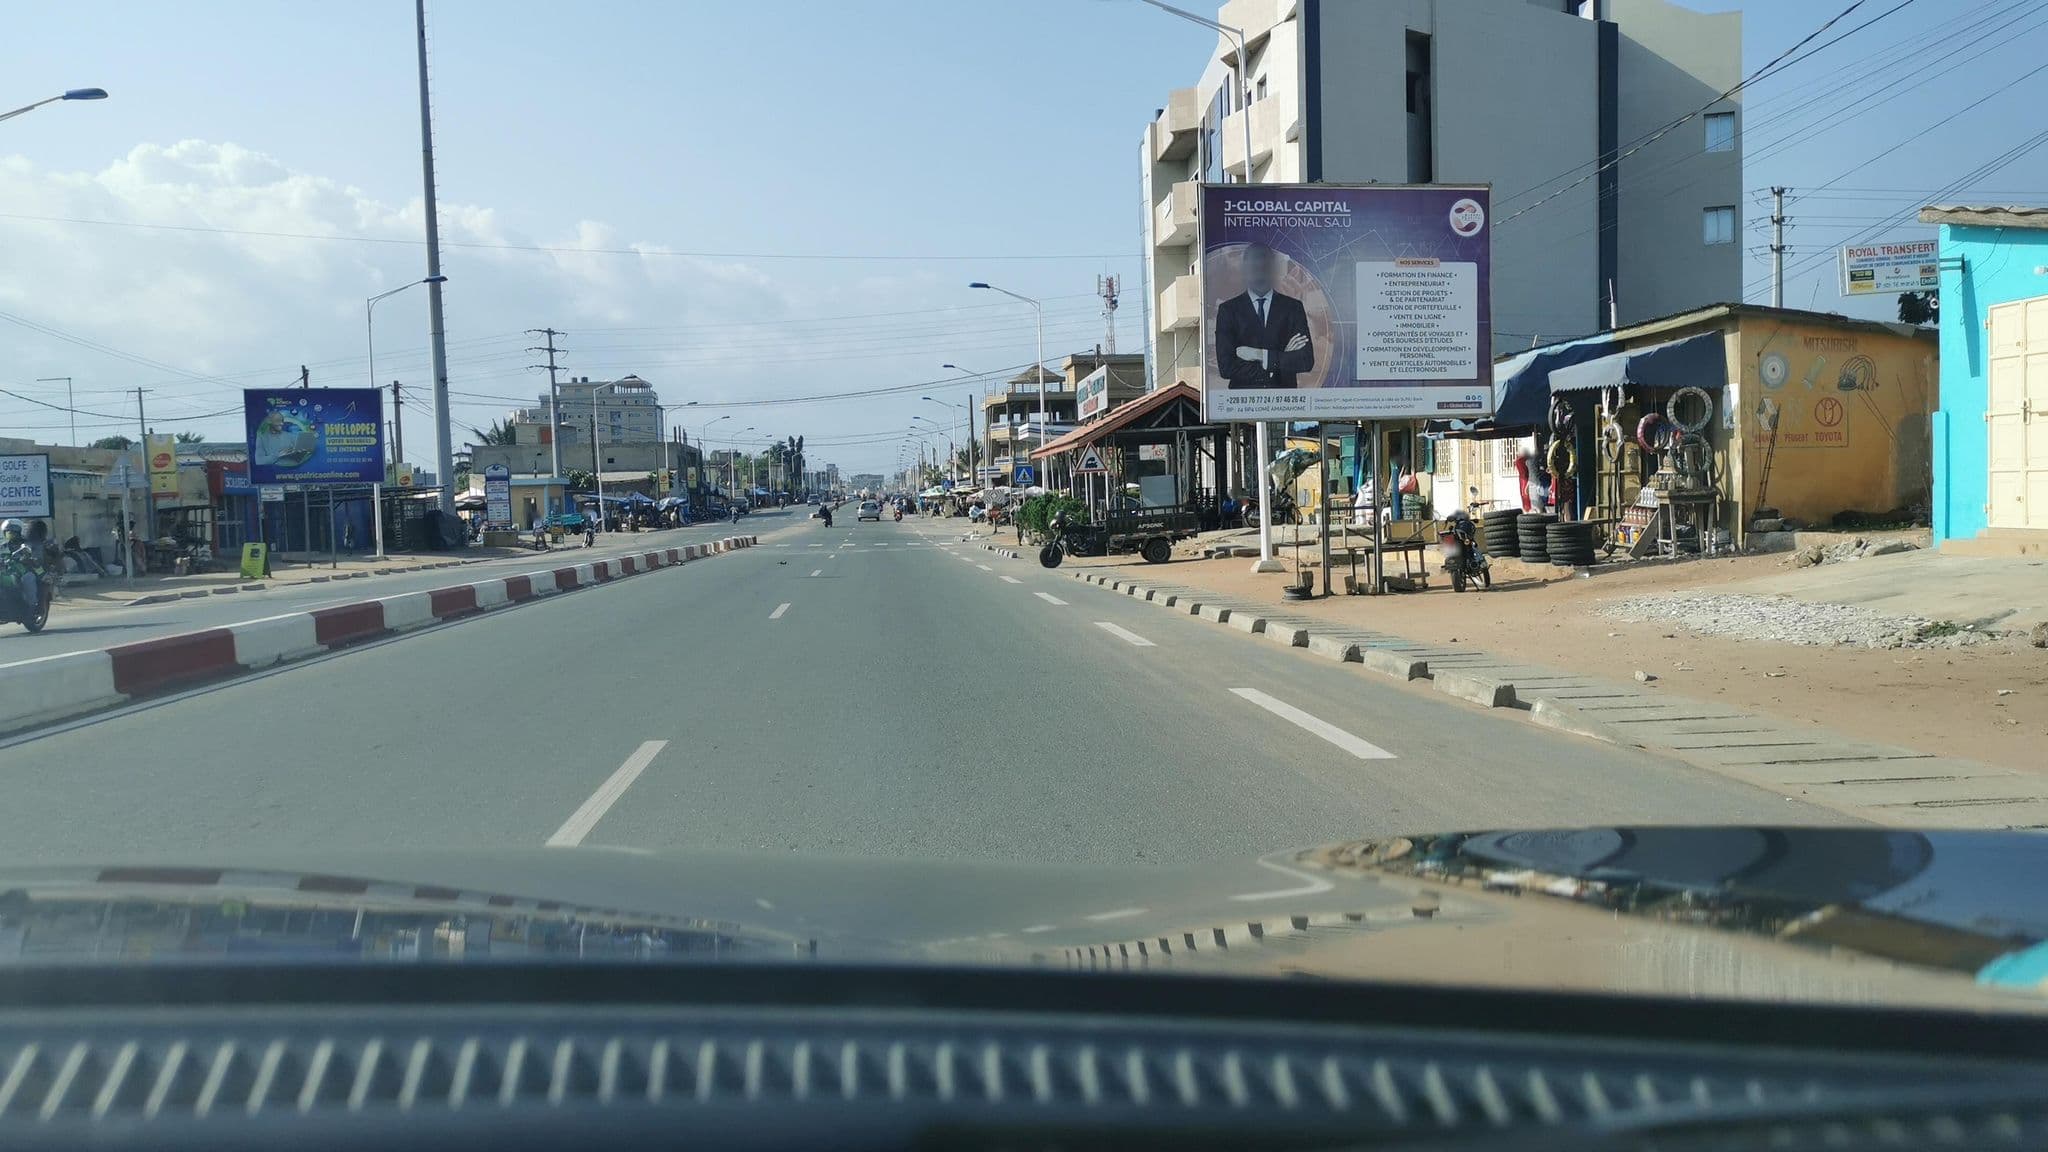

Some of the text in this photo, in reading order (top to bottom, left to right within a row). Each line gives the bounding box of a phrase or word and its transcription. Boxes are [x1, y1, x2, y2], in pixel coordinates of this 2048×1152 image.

[1224, 200, 1351, 213] J-GLOBAL CAPITAL
[1224, 216, 1323, 228] INTERNATIONAL
[1848, 242, 1935, 258] ROYAL TRANSFERT
[1815, 432, 1842, 442] TOYOTA
[2, 460, 28, 470] GOLFE
[24, 474, 28, 482] 2
